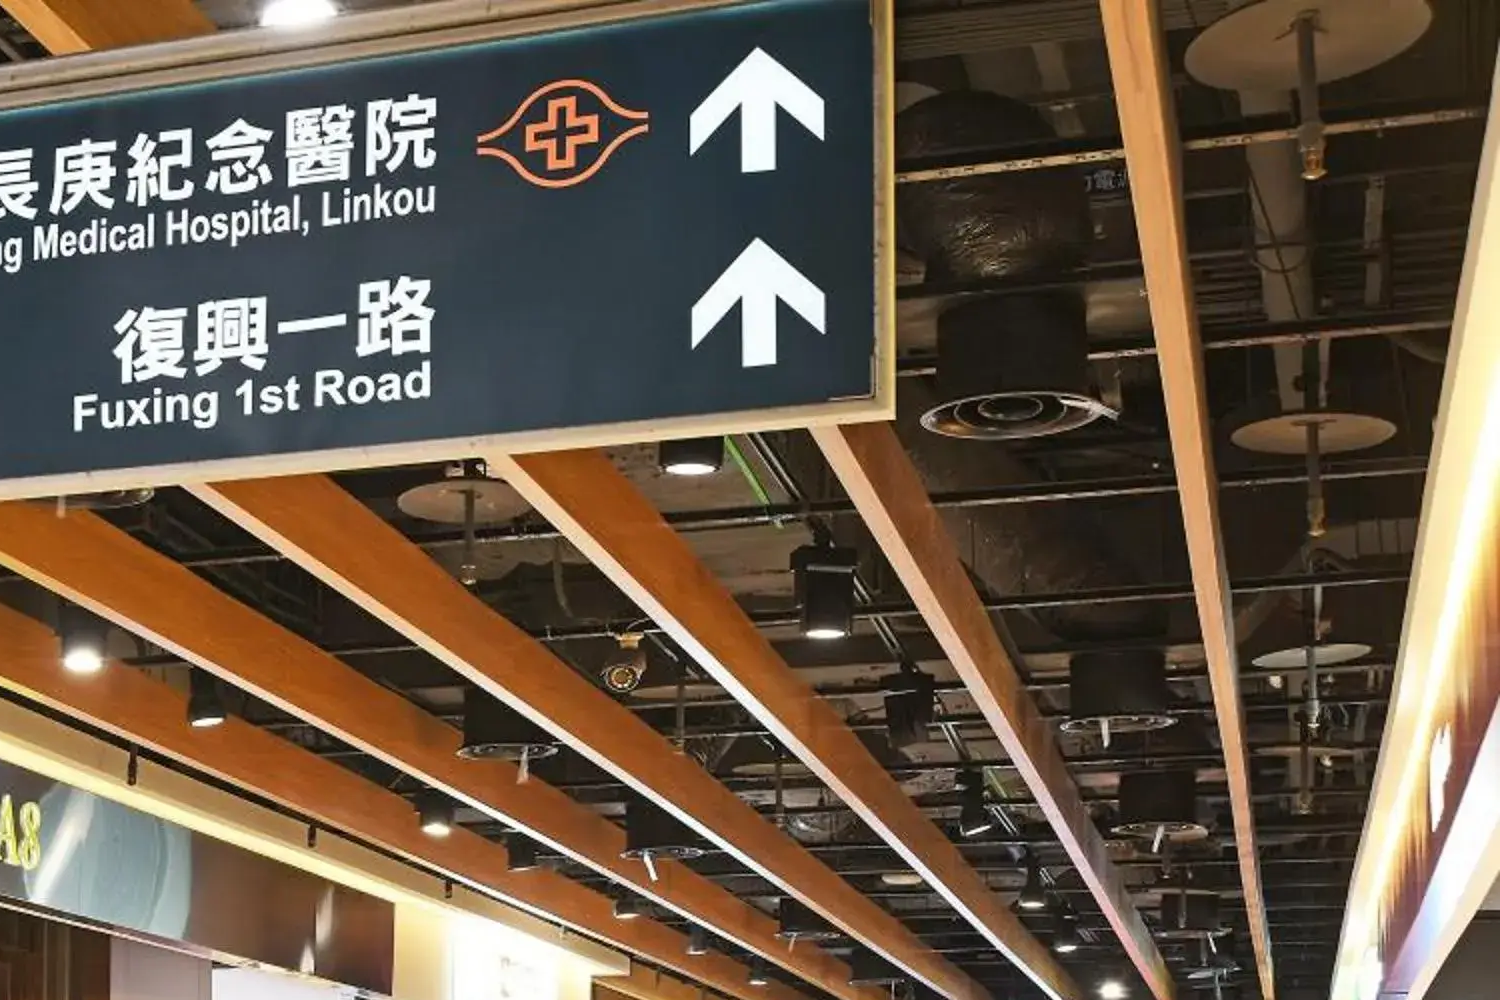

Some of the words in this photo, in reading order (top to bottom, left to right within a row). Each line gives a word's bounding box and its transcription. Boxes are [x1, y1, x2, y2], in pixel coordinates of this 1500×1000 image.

[33, 214, 156, 262] Medical
[165, 199, 310, 248] Hospital,
[322, 184, 437, 227] Linkou
[112, 275, 436, 385] 復興一路
[73, 387, 219, 431] Fuxing
[235, 377, 300, 416] 1st
[314, 361, 432, 406] Road
